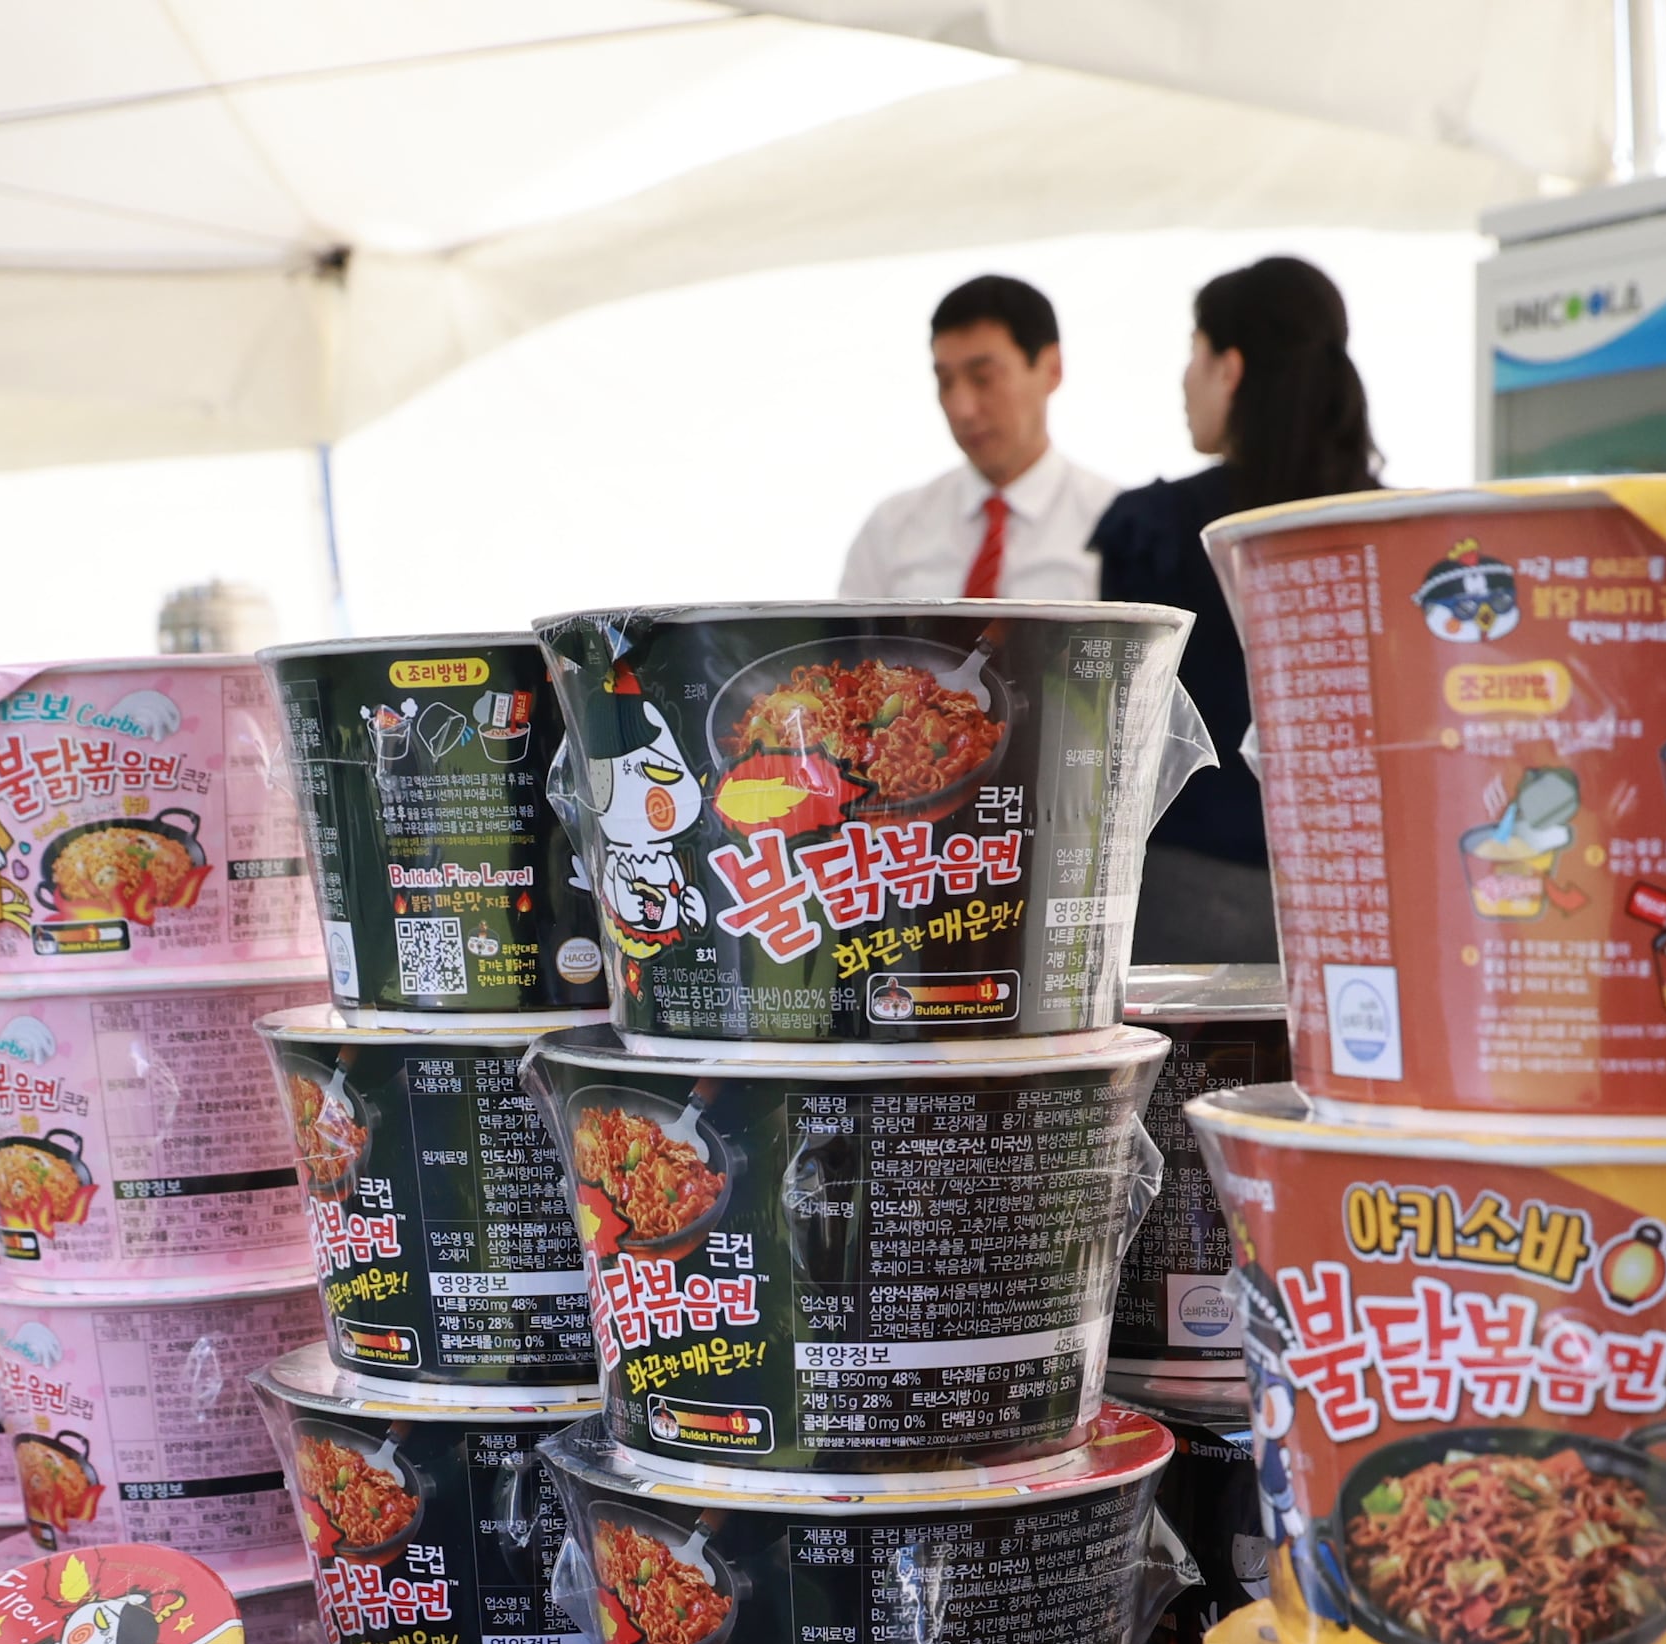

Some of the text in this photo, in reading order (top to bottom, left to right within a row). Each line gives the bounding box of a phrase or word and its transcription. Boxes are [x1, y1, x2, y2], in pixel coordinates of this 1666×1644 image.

[407, 662, 468, 683] 조리방법
[1072, 661, 1115, 680] 식품유형
[974, 784, 1024, 825] 큰컵
[388, 862, 534, 888] Buldak Fire Level
[434, 890, 483, 913] 매운맛
[485, 895, 511, 909] 지표
[707, 821, 1023, 965] 불닭볶음면
[830, 899, 1025, 980] 화끈한 매운맛!
[563, 951, 597, 964] HACCP
[695, 947, 718, 964] 호치
[476, 974, 506, 986] 당신의
[652, 988, 691, 1010] 액상스프
[829, 987, 861, 1012] 함유.
[914, 1002, 1004, 1016] Buldak Fire Level
[417, 1059, 455, 1075] 제품명
[474, 1076, 515, 1093] 유탕면
[801, 1090, 1083, 1114] 제품명 큰컵 불닭볶음면 품목보고번호
[795, 1113, 988, 1135] 식품유형 유탕면 포장재질
[895, 1136, 987, 1158] 소맥분(호주산,
[119, 1179, 183, 1198] 영양정보
[357, 1175, 395, 1211] 큰컵
[797, 1200, 855, 1218] 원재료명
[868, 1218, 956, 1238] 고추씨향미유,
[1345, 1180, 1593, 1286] 야키소바
[704, 1231, 754, 1270] 큰컵
[868, 1250, 1064, 1277] 후레이크 볶음참깨, 구운김후레이크
[351, 1267, 409, 1304] 매운맛!
[437, 1275, 510, 1293] 영양정보
[940, 1277, 1038, 1301] 서울특별시 성북구
[528, 1313, 585, 1330] 트랜스지방
[868, 1301, 978, 1322] 삼양식품 홈페이지
[1182, 1305, 1229, 1318] 소비자중심
[868, 1315, 1023, 1339] 고객만족팀 수신자요금부담
[439, 1333, 494, 1350] 콜레스테롤
[804, 1345, 892, 1367] 영양정보
[626, 1341, 768, 1395] 화끈한 매운맛!
[801, 1361, 1036, 1389] 나트륨 950 mg 48% 탄수화물 19%
[801, 1375, 1077, 1410] 지방 28% 트랜스지방 포화지방 53%
[801, 1406, 1021, 1432] 콜레스테롤 0% 단백질 16%
[123, 1481, 185, 1499] 영양정보
[404, 1543, 445, 1577] 큰컵
